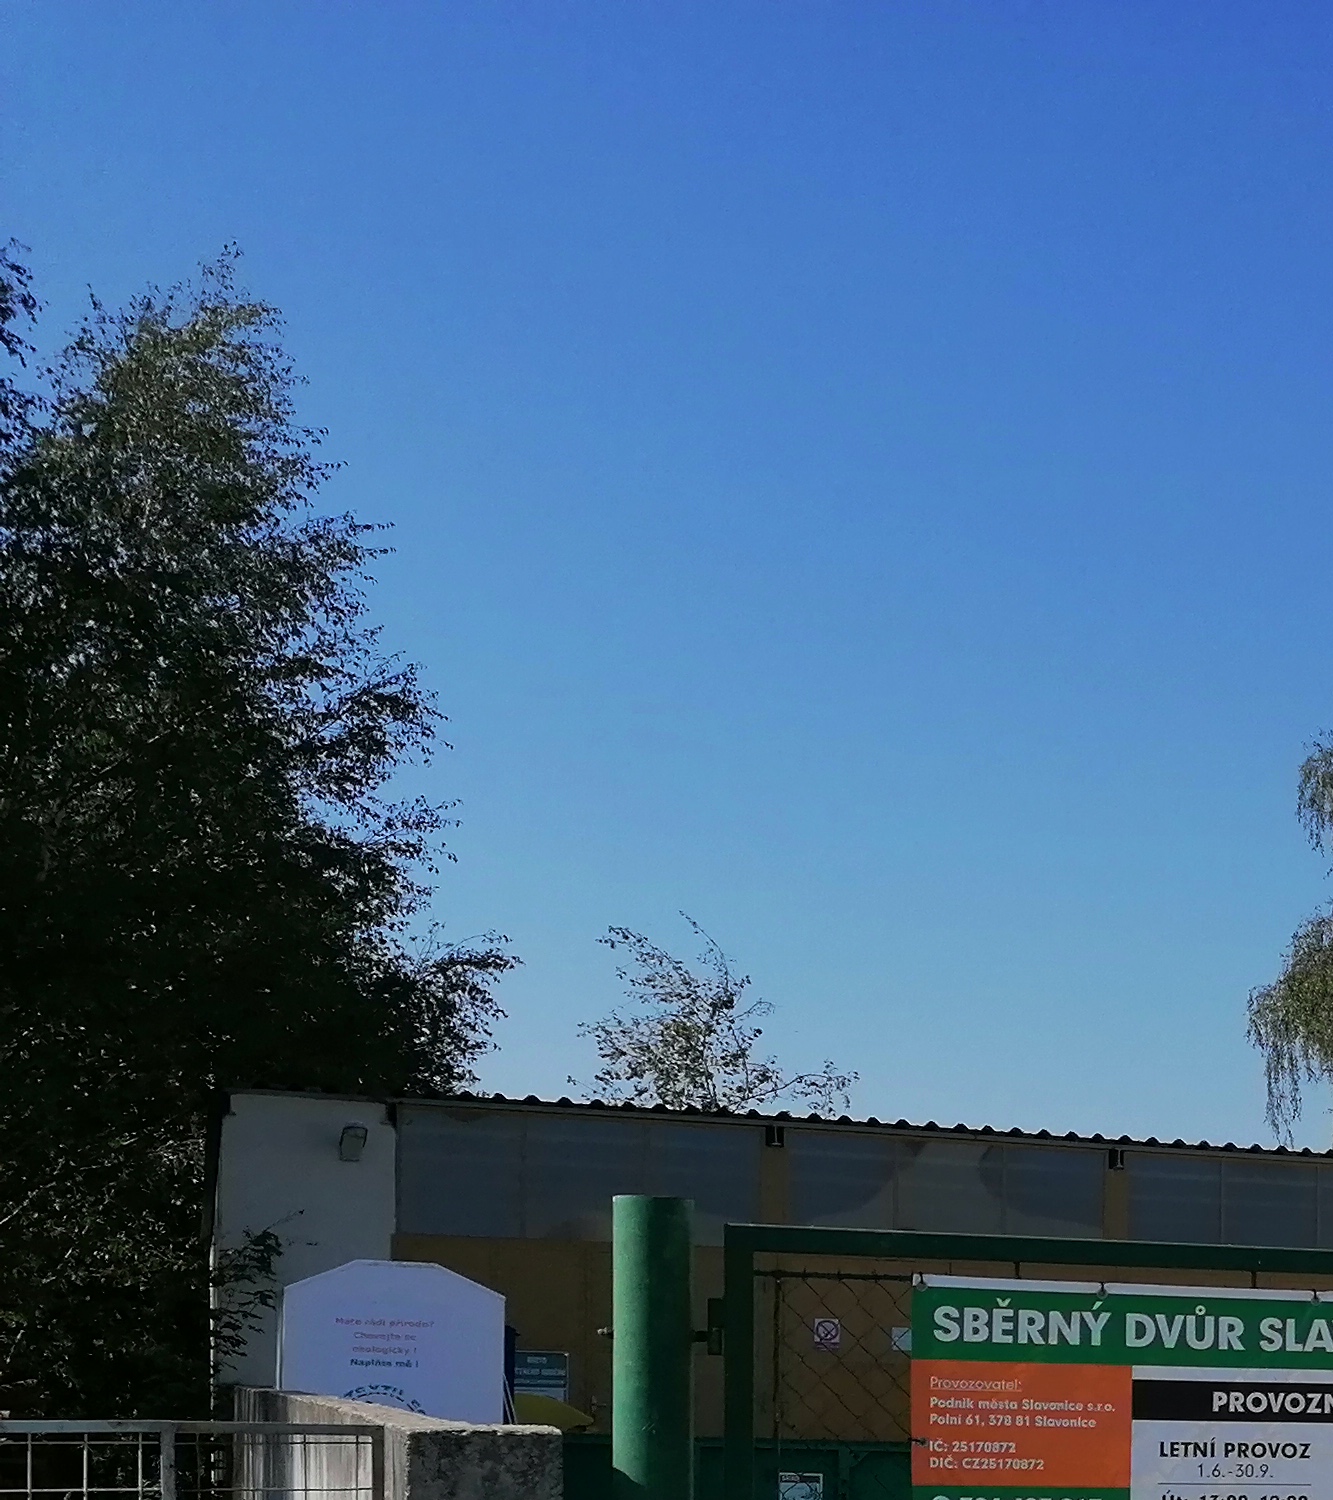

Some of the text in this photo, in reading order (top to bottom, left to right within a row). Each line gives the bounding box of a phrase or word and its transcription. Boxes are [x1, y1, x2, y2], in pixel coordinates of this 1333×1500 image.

[933, 1297, 1112, 1346] SBĚRNÝ
[1126, 1305, 1245, 1350] DVŮR
[930, 1377, 1022, 1390] Provozovatel:
[930, 1397, 1115, 1412] Podnik města Slavonice s.r.o.
[965, 1414, 984, 1426] 61,
[989, 1415, 1011, 1426] 378
[1015, 1415, 1030, 1427] 81
[1035, 1416, 1096, 1428] Slavonice
[930, 1438, 1016, 1453] IČ: 25170872
[1159, 1440, 1311, 1459] LETNÍ PROVOZ
[930, 1454, 1044, 1470] DIČ: CZ25170872
